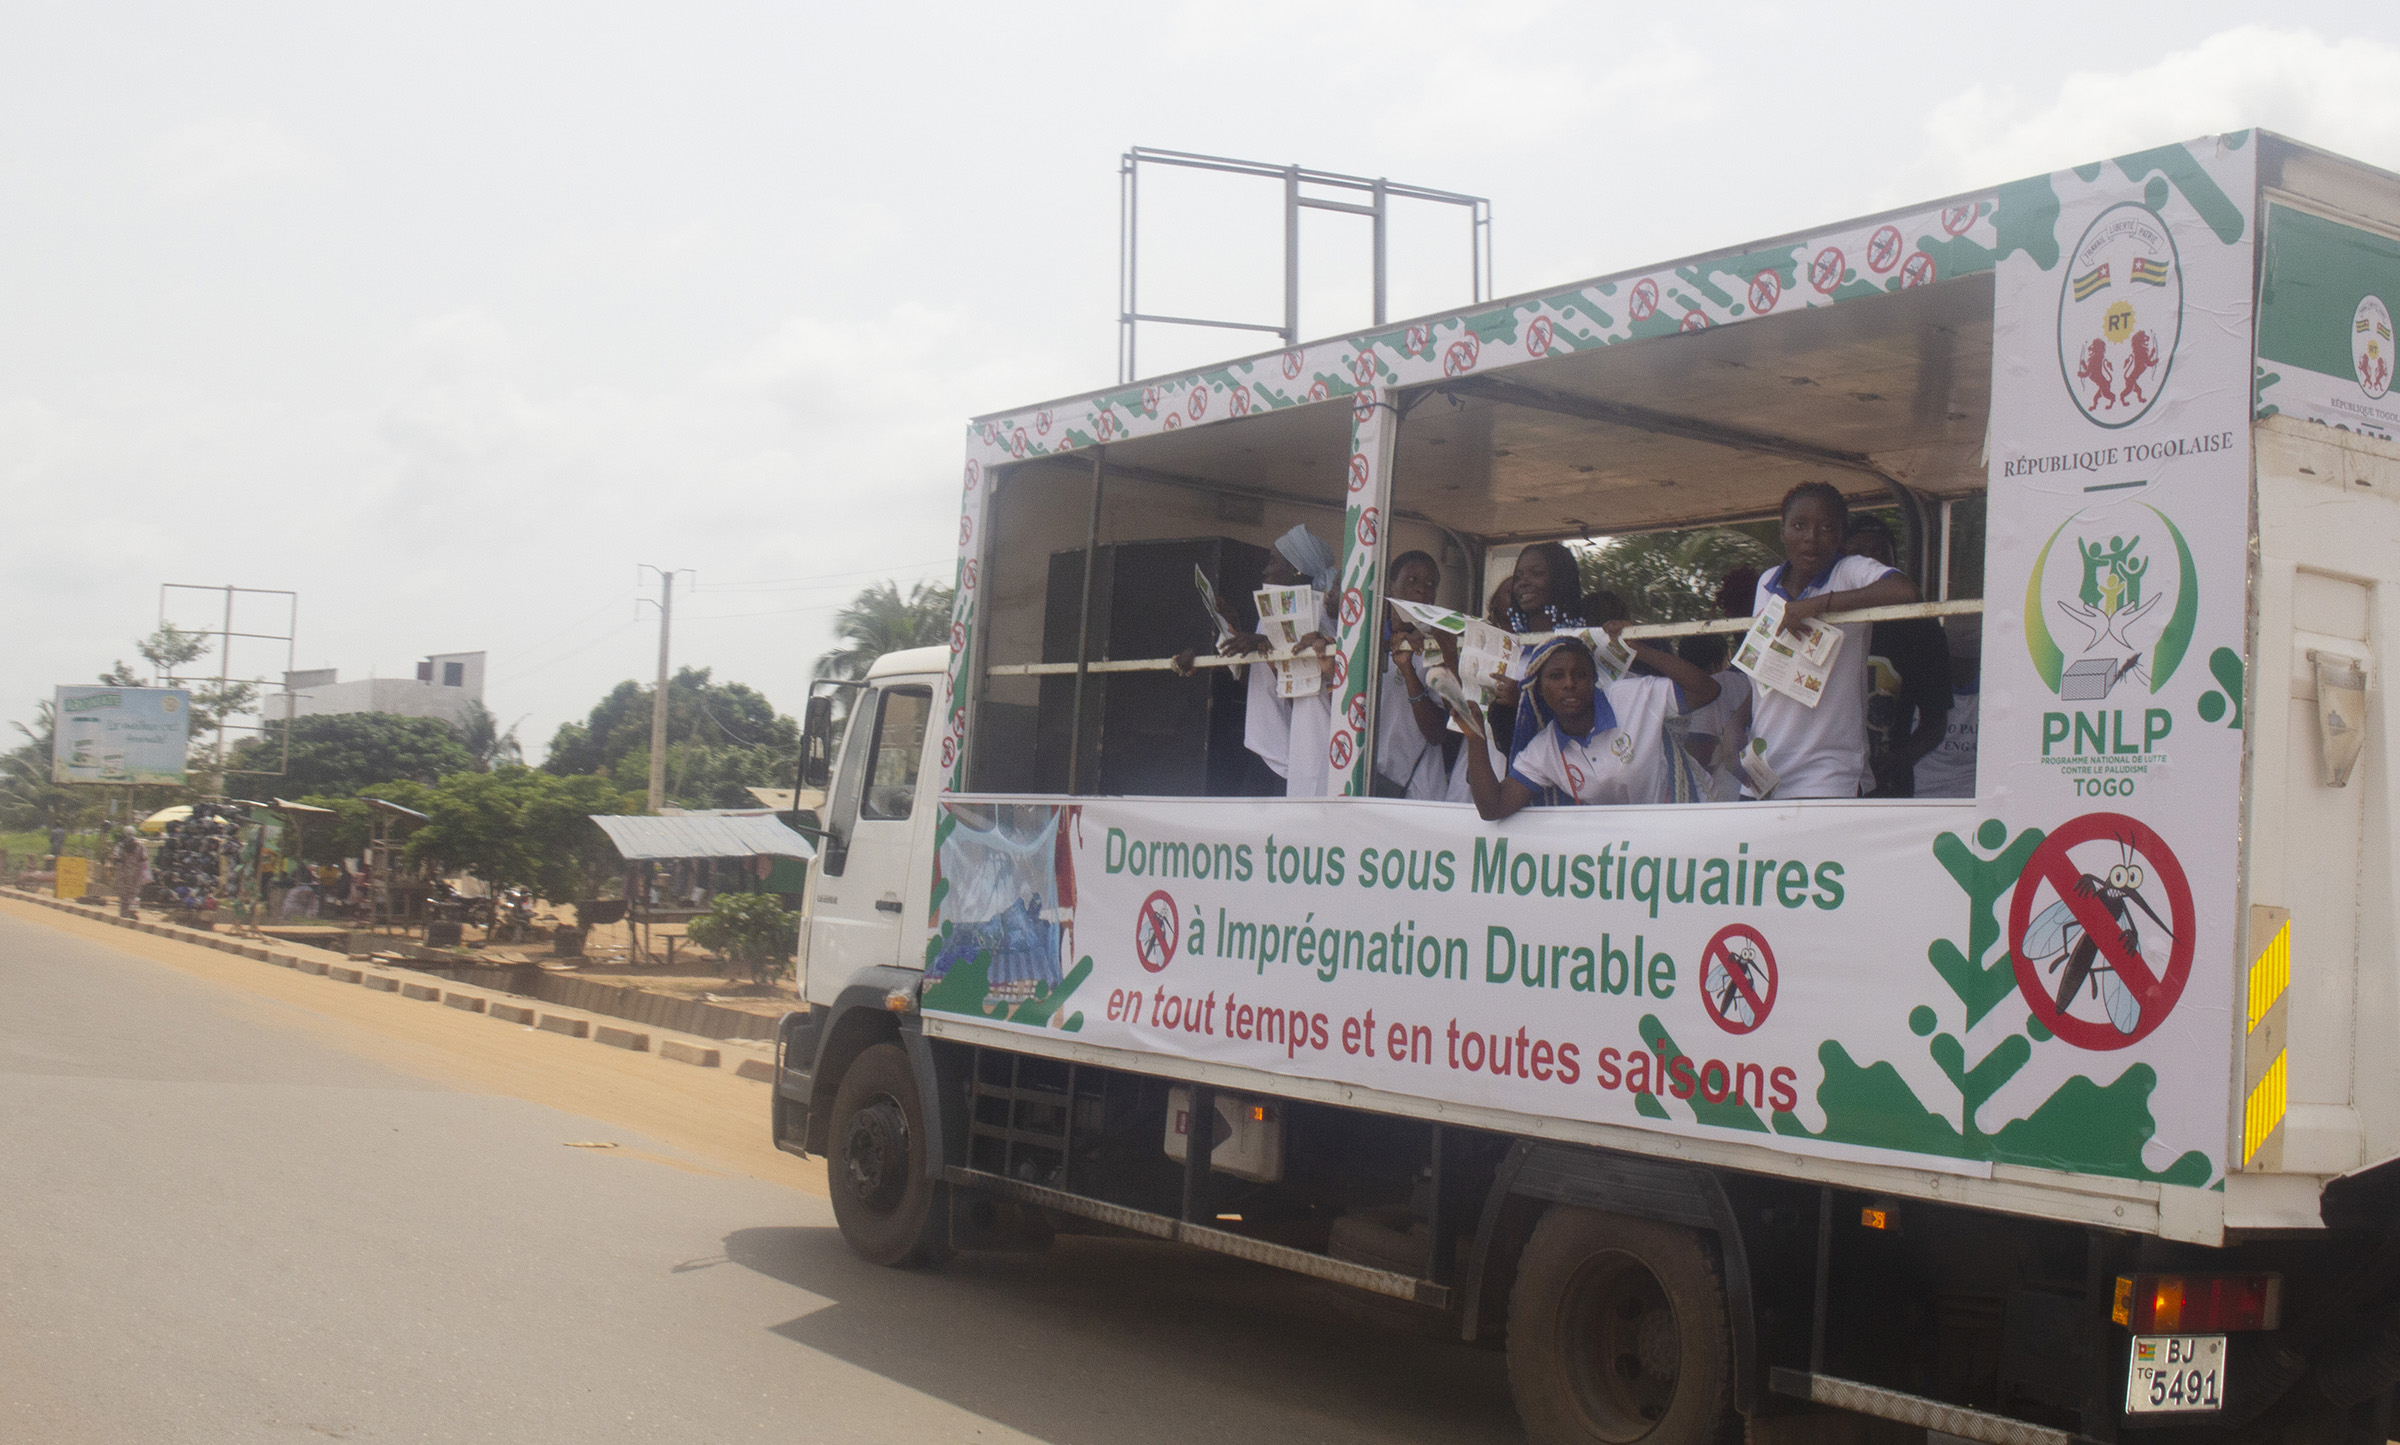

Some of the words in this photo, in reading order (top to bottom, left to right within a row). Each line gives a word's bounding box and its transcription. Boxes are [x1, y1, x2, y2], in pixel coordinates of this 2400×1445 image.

[2084, 236, 2106, 259] TRAVAIL
[2108, 220, 2136, 235] LIBERTÉ
[2138, 228, 2159, 244] PATRIE
[2108, 312, 2132, 332] RT
[2330, 398, 2375, 417] RÉPUBLIQUE
[2003, 448, 2118, 478] RÉPUBLIQUE
[2123, 431, 2234, 463] TOGOLAISE
[2042, 708, 2173, 756] PNLP
[2041, 756, 2089, 765] PROGRAMME
[2090, 755, 2130, 764] NATIONAL
[2132, 755, 2143, 763] DE
[2144, 754, 2167, 763] LUTTE
[2061, 766, 2092, 775] CONTRE
[2093, 766, 2103, 774] LE
[2105, 765, 2148, 774] PALUDISME
[2073, 777, 2135, 797] TOGO
[1105, 827, 1253, 882] Dormons
[1265, 834, 1346, 887] tous
[1357, 844, 1456, 892] sous
[1471, 836, 1845, 919] Moustiquaires
[1187, 904, 1205, 956] à
[1216, 907, 1468, 983] Imprégnation
[1485, 925, 1676, 1000] Durable
[1106, 988, 1143, 1024] en
[1151, 984, 1215, 1035] tout
[1224, 992, 1330, 1060] temps
[1341, 1008, 1376, 1058] et
[1387, 1020, 1433, 1065] en
[1446, 1017, 1581, 1085] toutes
[1597, 1038, 1798, 1113] saisons
[2165, 1338, 2195, 1364] BJ
[2137, 1367, 2153, 1379] TG
[2148, 1369, 2219, 1406] 5491
